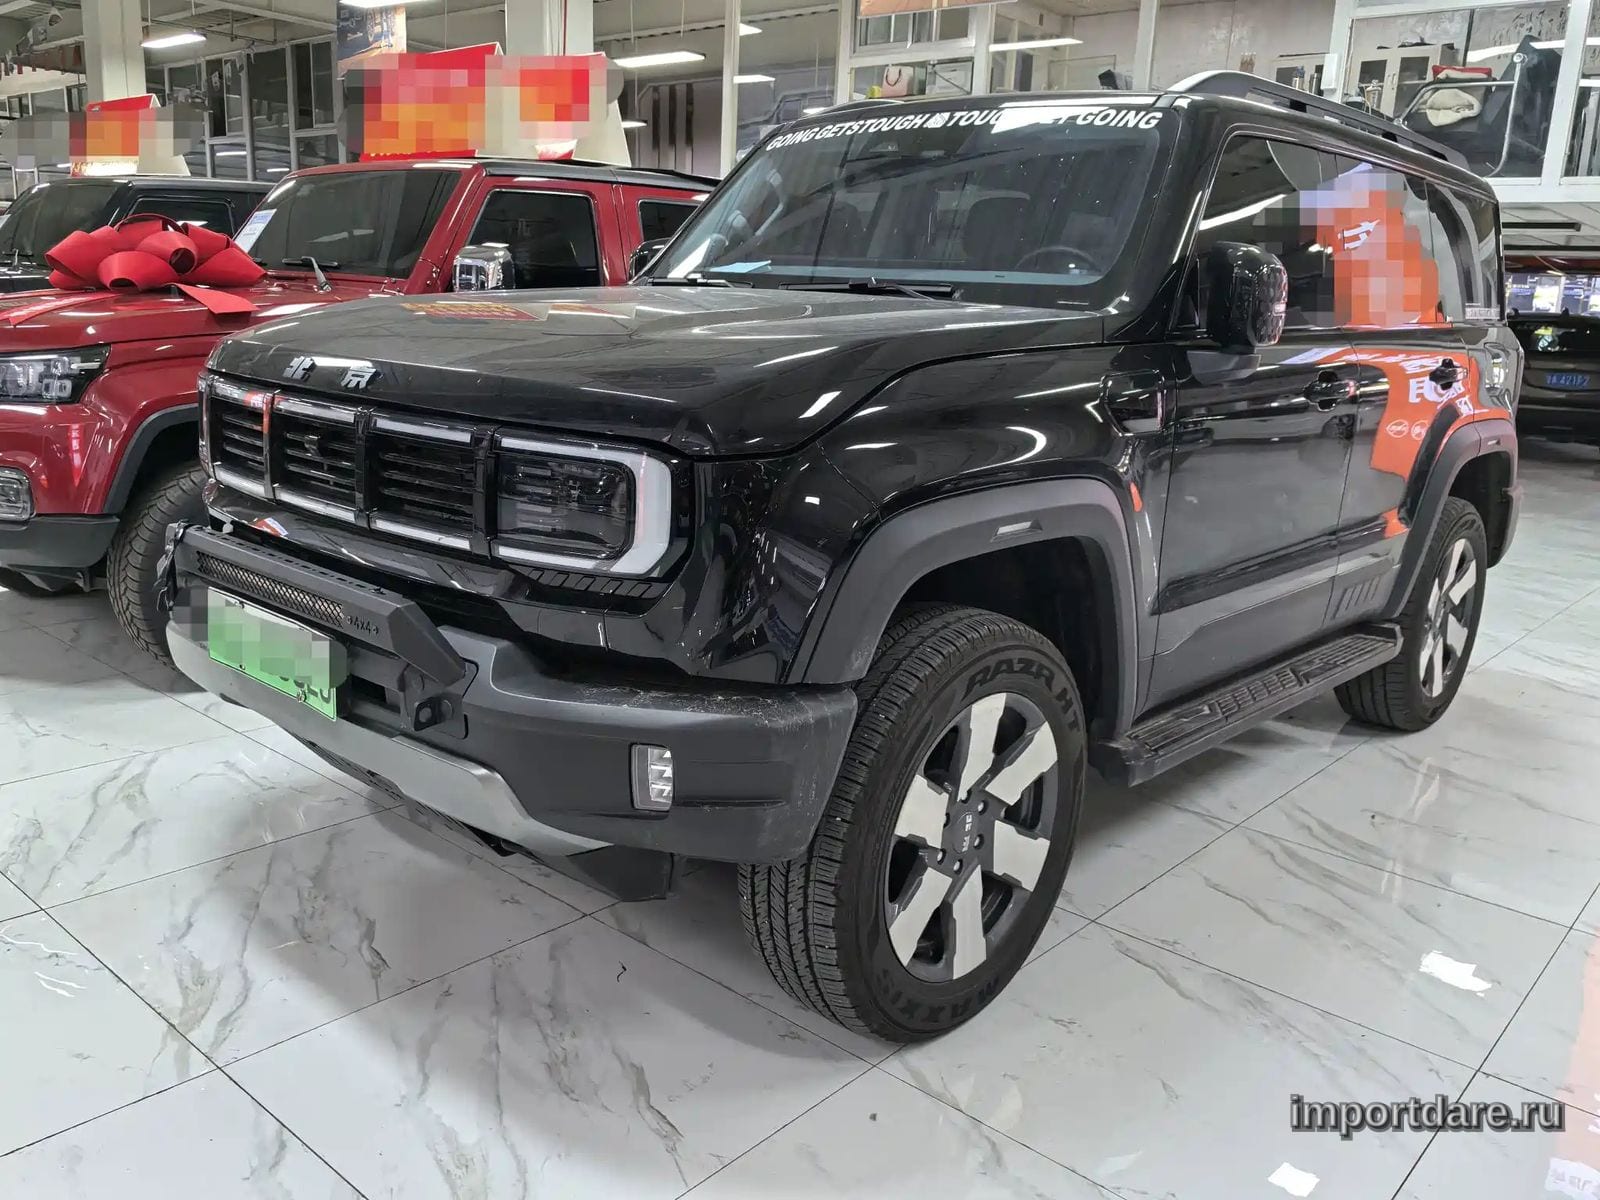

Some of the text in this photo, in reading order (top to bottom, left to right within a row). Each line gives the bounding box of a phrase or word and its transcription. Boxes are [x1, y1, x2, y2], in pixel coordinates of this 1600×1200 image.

[766, 126, 820, 151] GOING
[946, 109, 1006, 127] TOU
[1076, 109, 1163, 129] GOING
[282, 355, 376, 389] 北京
[961, 657, 1055, 701] RAZR
